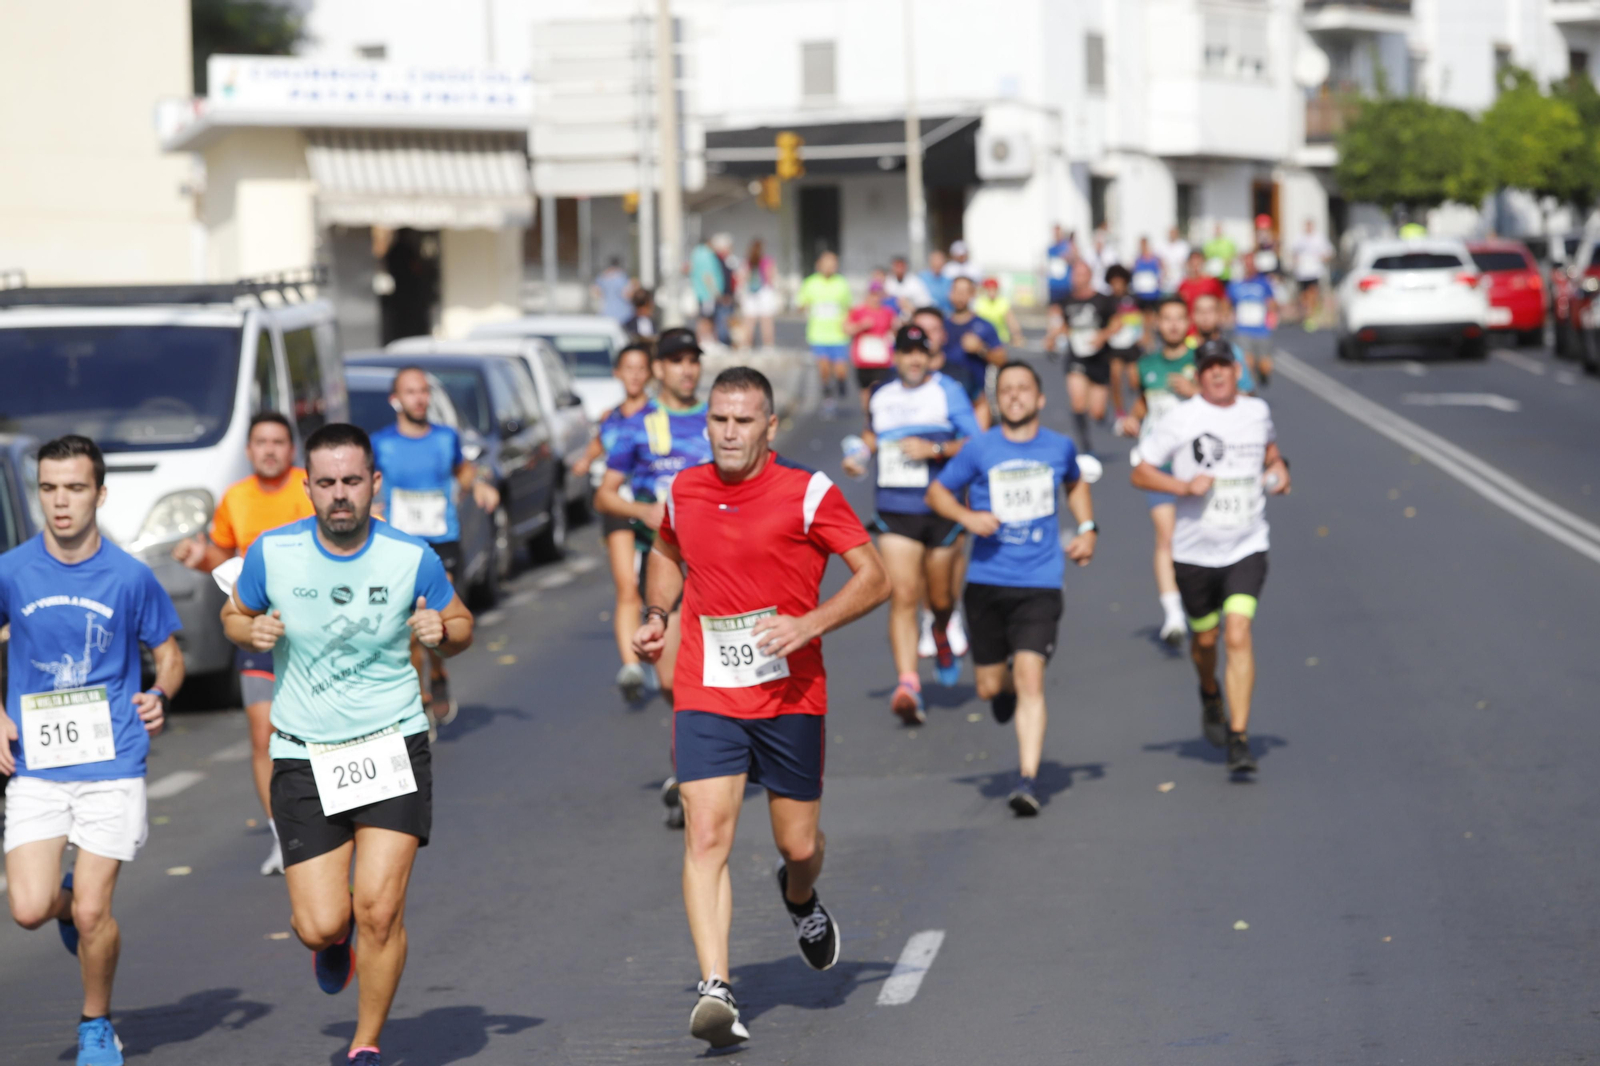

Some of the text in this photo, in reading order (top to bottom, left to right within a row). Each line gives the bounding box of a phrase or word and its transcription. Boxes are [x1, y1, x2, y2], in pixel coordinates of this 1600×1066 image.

[719, 644, 754, 667] 539
[40, 721, 79, 746] 516
[332, 757, 377, 789] 280
